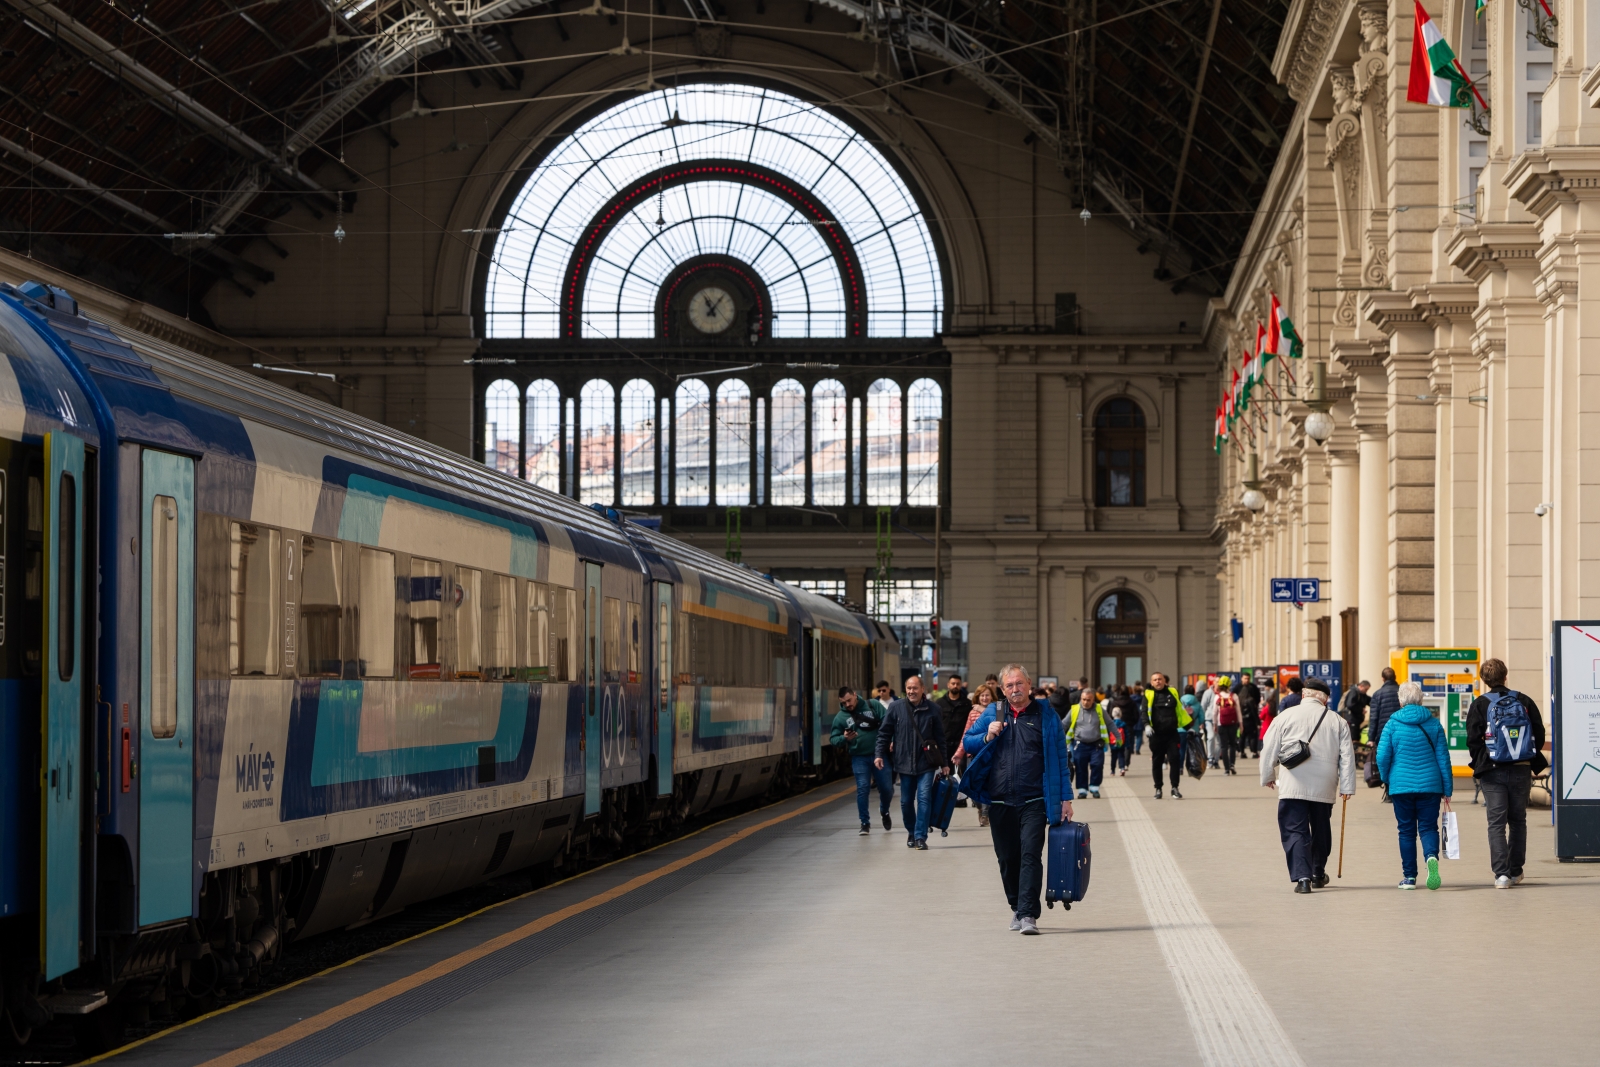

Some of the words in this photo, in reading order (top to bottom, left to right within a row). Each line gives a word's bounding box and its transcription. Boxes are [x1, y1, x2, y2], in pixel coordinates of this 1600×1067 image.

[287, 545, 294, 581] 2
[1307, 664, 1314, 674] 6
[1321, 664, 1330, 674] B
[236, 743, 262, 793] MÁV
